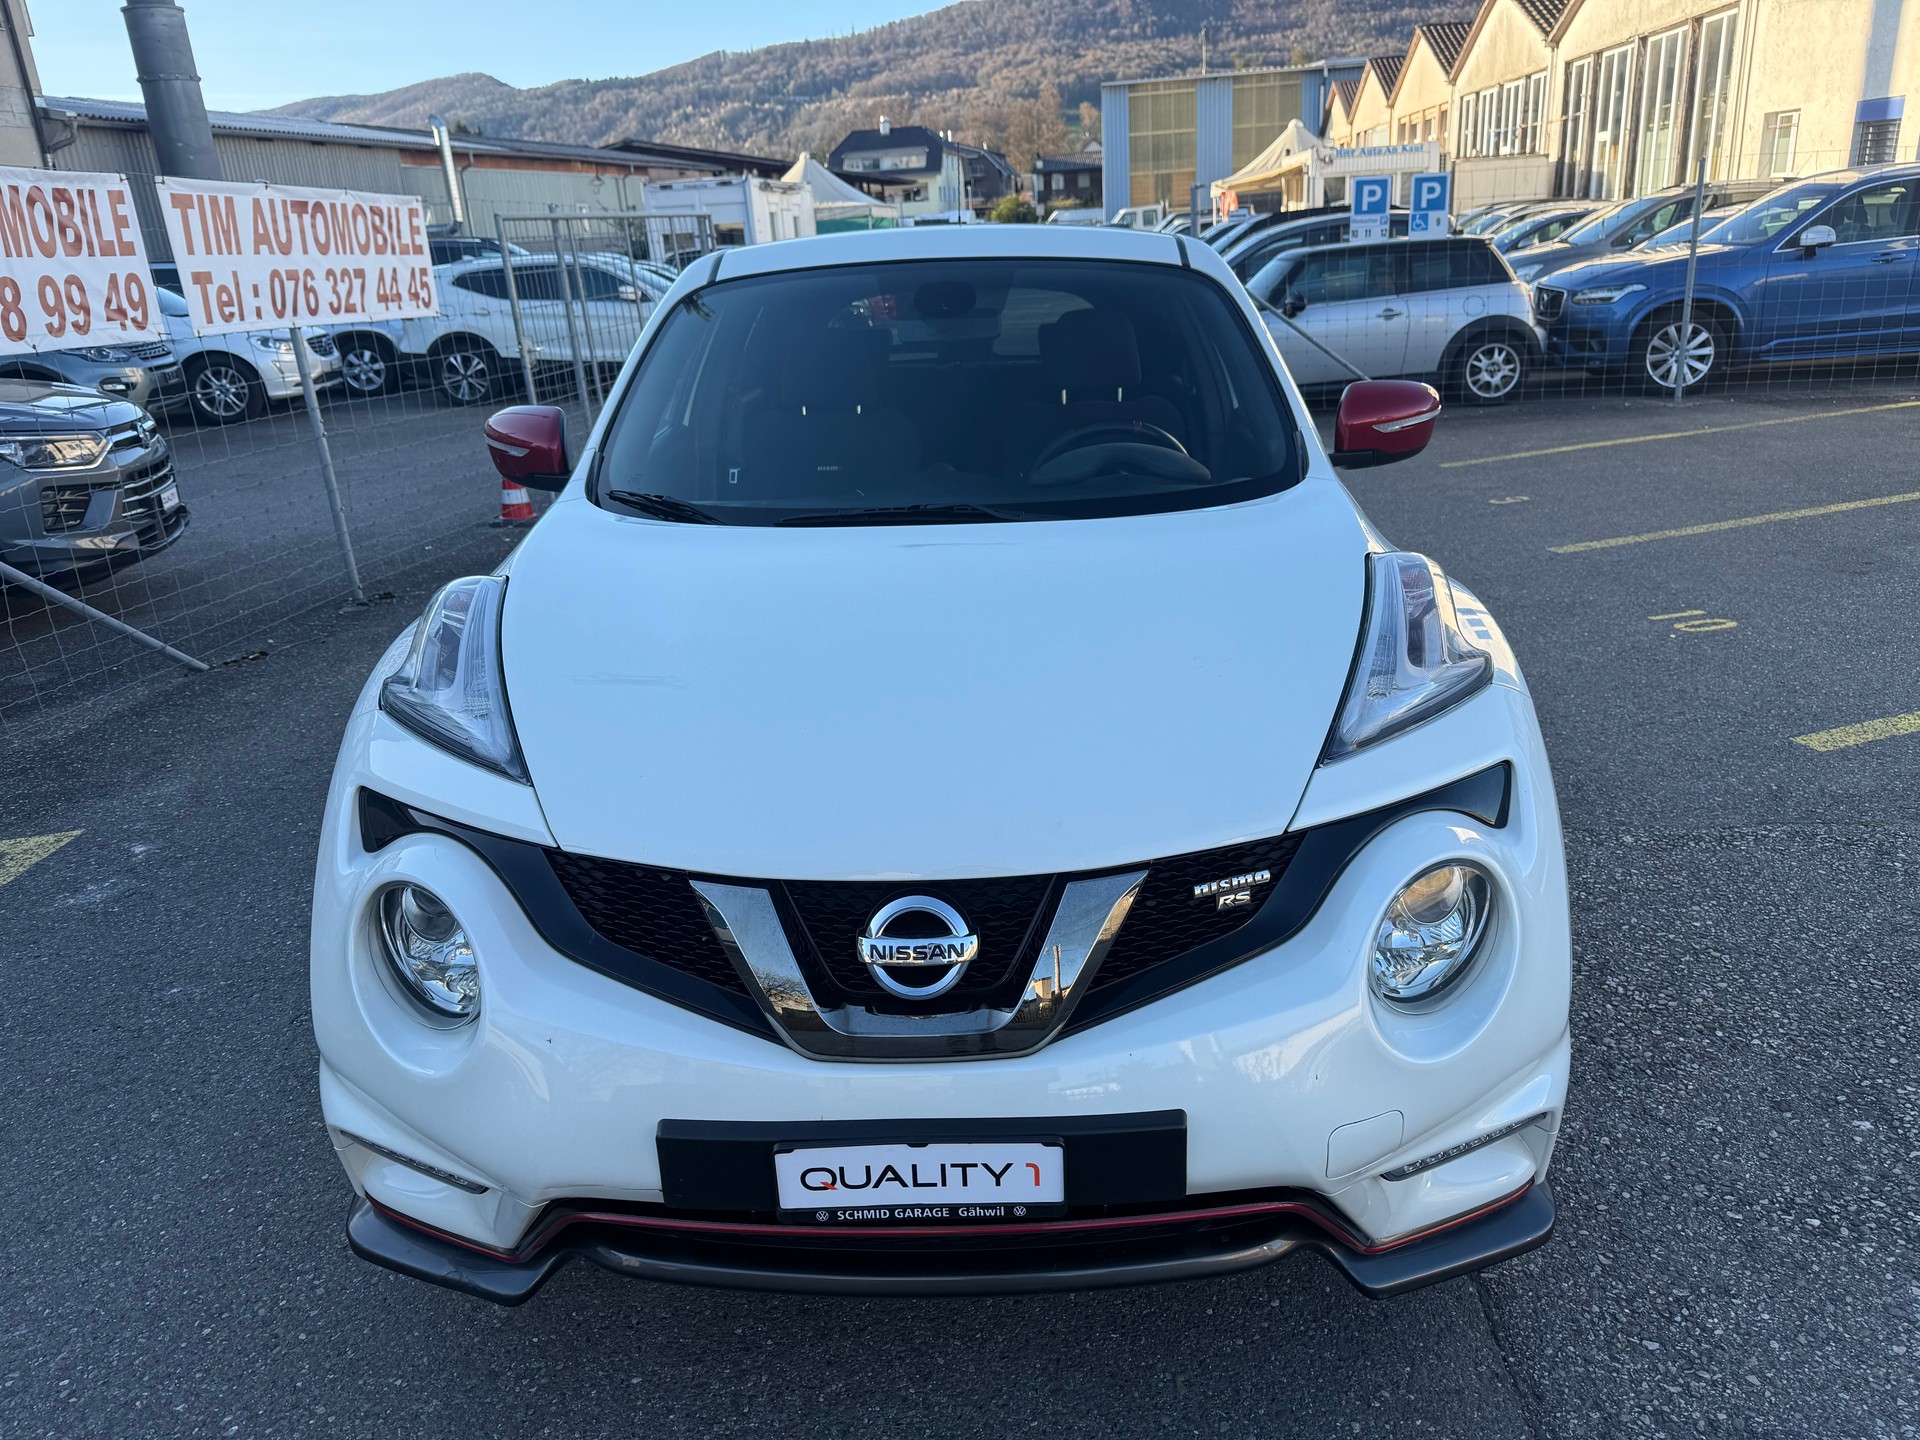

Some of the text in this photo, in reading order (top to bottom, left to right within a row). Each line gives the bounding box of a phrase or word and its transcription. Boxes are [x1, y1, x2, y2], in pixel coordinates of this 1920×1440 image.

[1361, 185, 1382, 211] P
[1421, 182, 1441, 208] P
[0, 184, 137, 258] MOBILE
[170, 192, 424, 256] TIM AUTOMOBILE
[1365, 228, 1371, 238] 11
[37, 274, 91, 338] 99
[104, 272, 148, 331] 49
[269, 268, 319, 319] 076
[325, 268, 366, 315] 327
[376, 267, 402, 311] 44
[408, 267, 431, 309] 45
[1194, 869, 1271, 898] nismo
[1217, 890, 1250, 910] RS
[869, 942, 965, 961] NISSAN
[800, 1162, 1041, 1192] QUALITY 1
[837, 1208, 890, 1221] SCHMID
[894, 1207, 950, 1219] GARAGE
[958, 1205, 1005, 1217] Gähwil
